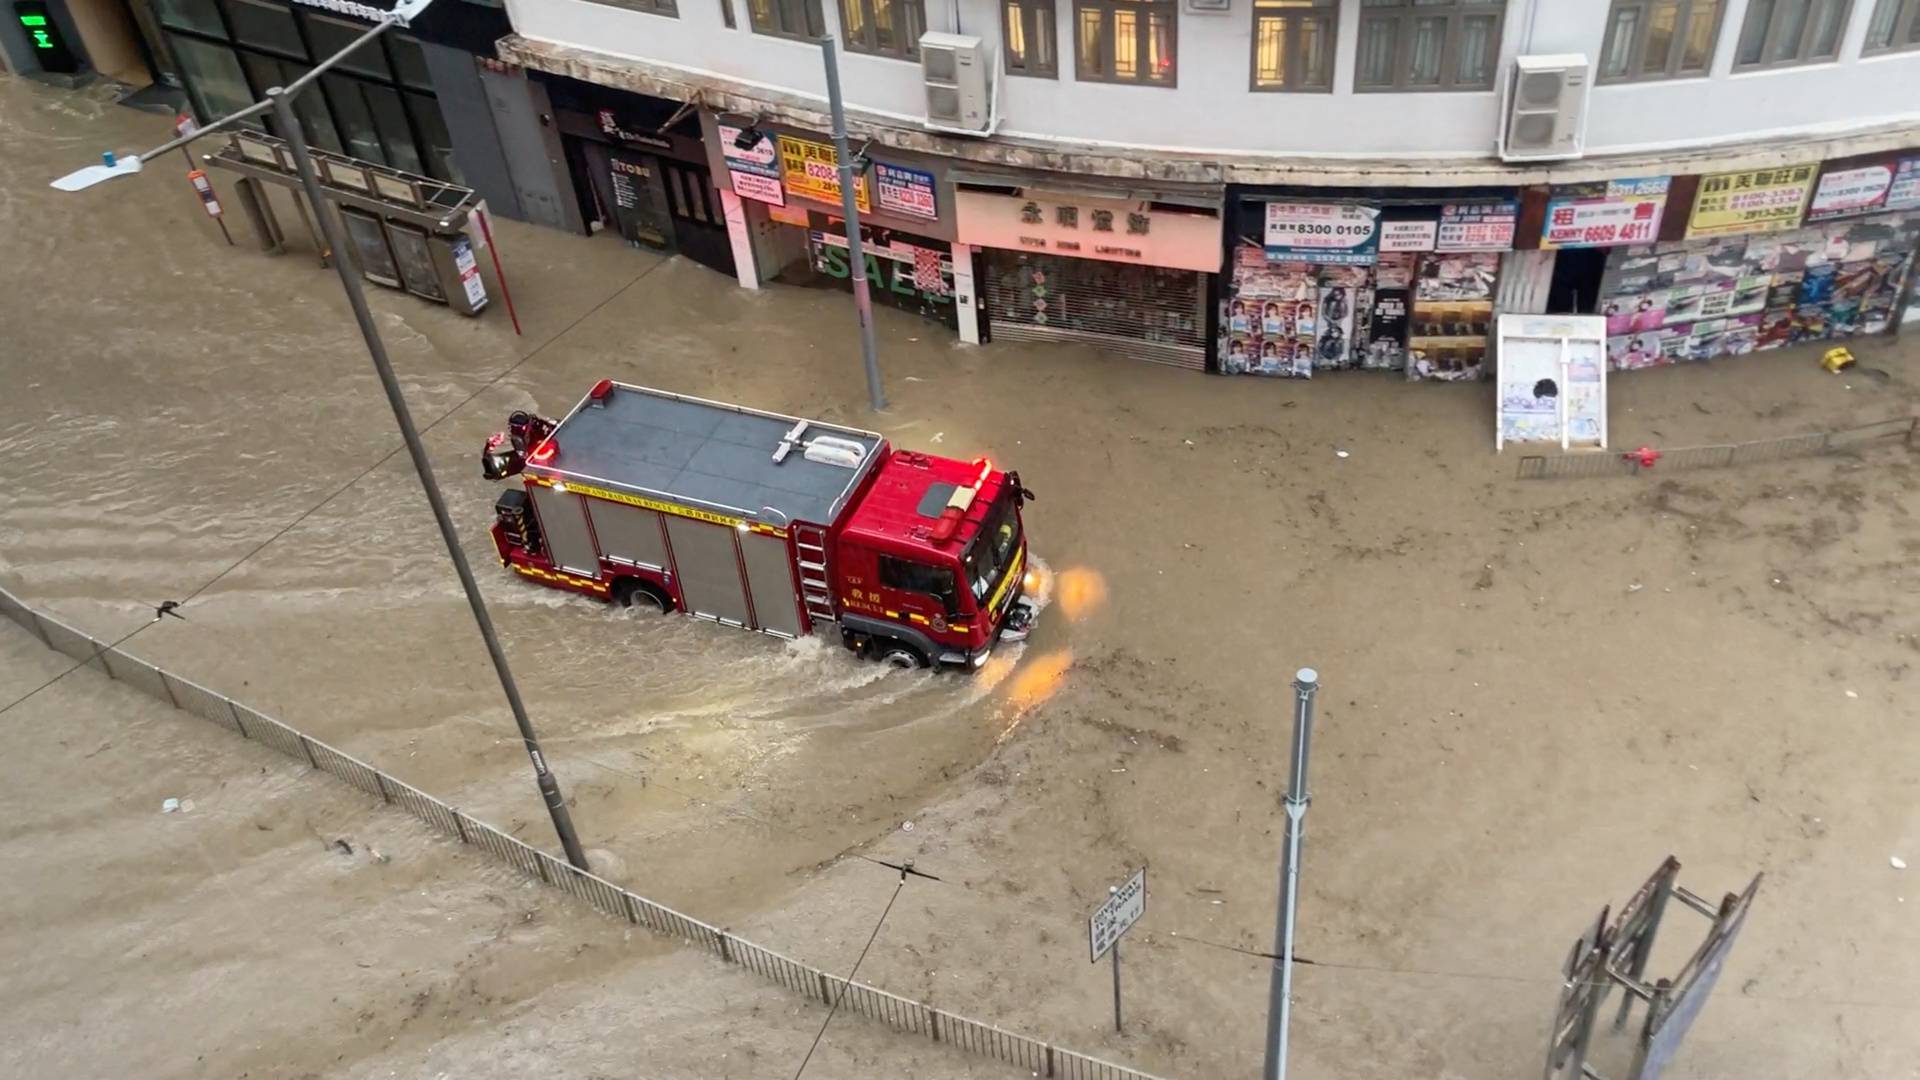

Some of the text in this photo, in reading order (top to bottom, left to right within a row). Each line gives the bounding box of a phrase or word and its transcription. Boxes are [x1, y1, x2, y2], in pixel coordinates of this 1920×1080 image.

[1552, 208, 1575, 226] 租
[1297, 225, 1332, 235] 8300
[1336, 225, 1371, 236] 0105
[1549, 221, 1652, 242] KENNY 6609 4811
[1094, 880, 1136, 924] GIVE WAY
[1110, 882, 1141, 916] TRAMS
